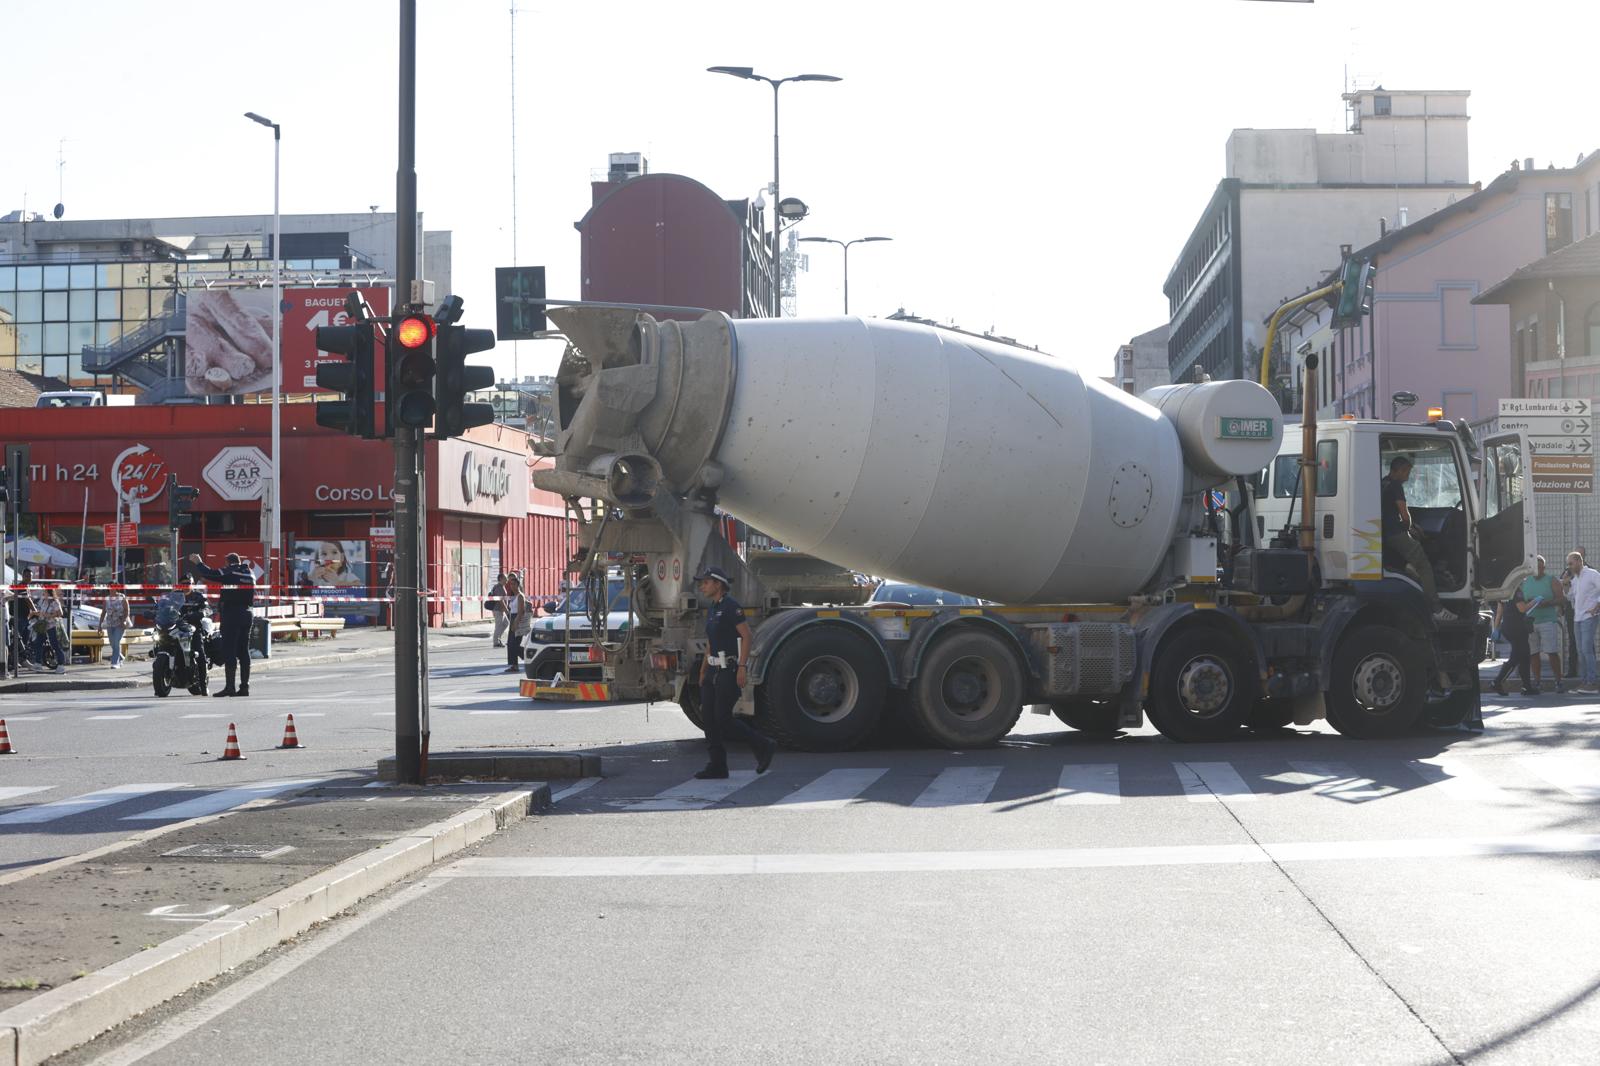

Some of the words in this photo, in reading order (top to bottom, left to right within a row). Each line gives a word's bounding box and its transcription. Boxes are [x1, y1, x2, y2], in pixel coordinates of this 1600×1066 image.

[305, 298, 347, 307] BAGUET
[304, 359, 311, 369] 3
[1510, 403, 1524, 412] Rgt.
[1240, 420, 1268, 432] IMER
[1501, 422, 1528, 430] centro
[1535, 441, 1563, 449] tradale
[122, 462, 163, 481] 24/7
[225, 466, 261, 480] BAR
[1573, 480, 1591, 489] ICA
[315, 485, 374, 501] Corso
[378, 485, 396, 501] Lo
